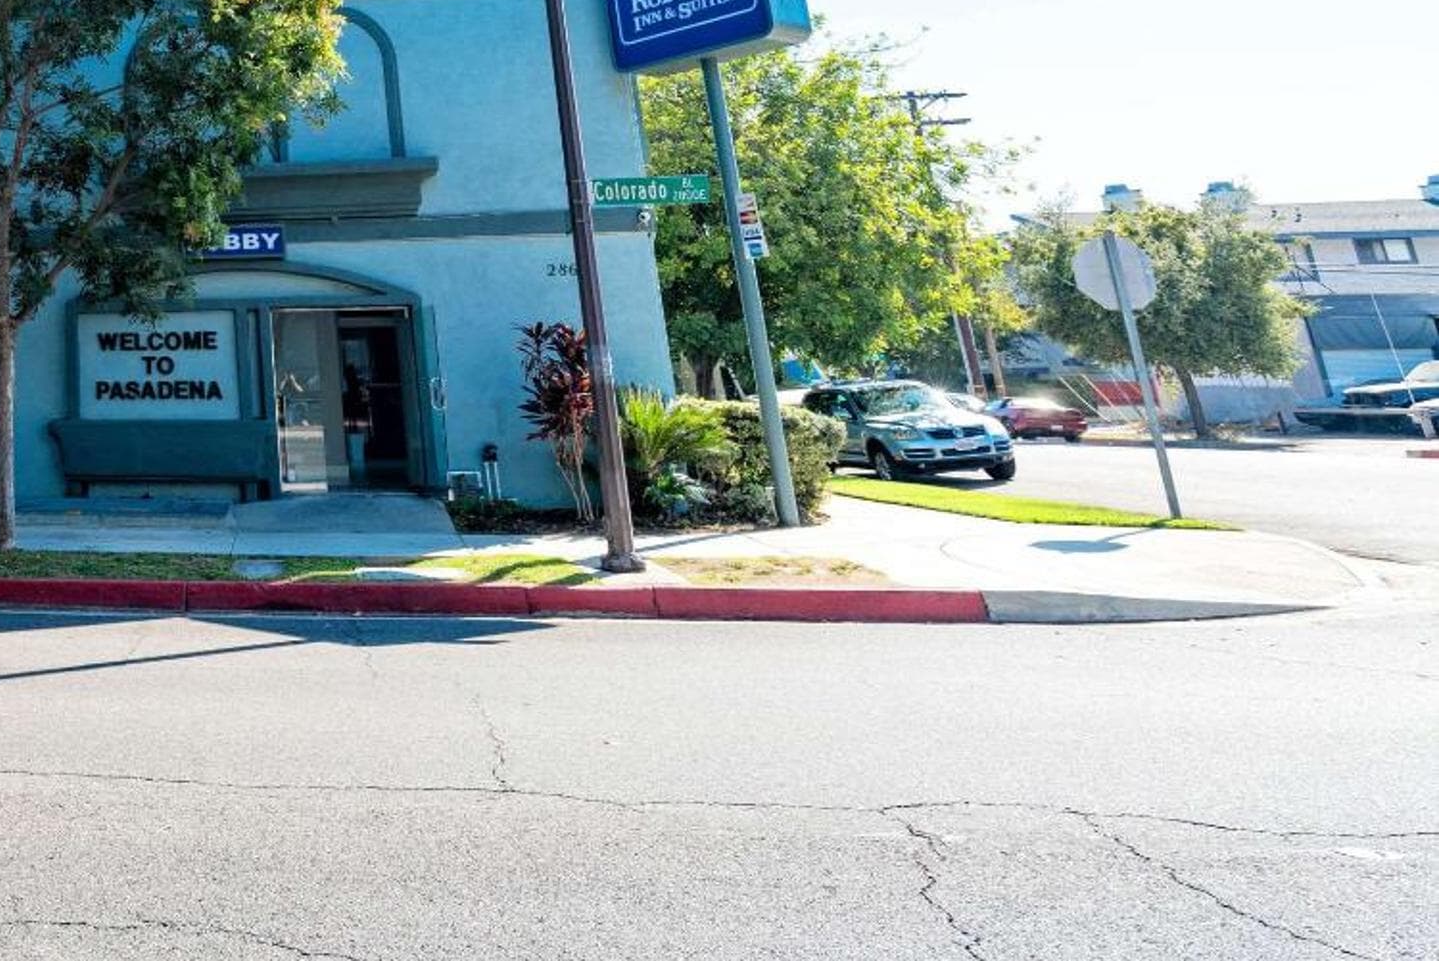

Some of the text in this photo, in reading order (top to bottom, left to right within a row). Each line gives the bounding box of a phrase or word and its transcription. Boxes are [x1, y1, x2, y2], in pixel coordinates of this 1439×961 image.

[633, 10, 663, 32] INN
[664, 6, 677, 20] &
[594, 180, 667, 201] Colorado
[209, 233, 280, 250] BBY
[97, 331, 218, 351] WELCOME
[141, 356, 175, 375] TO
[96, 381, 223, 400] PASADENA
